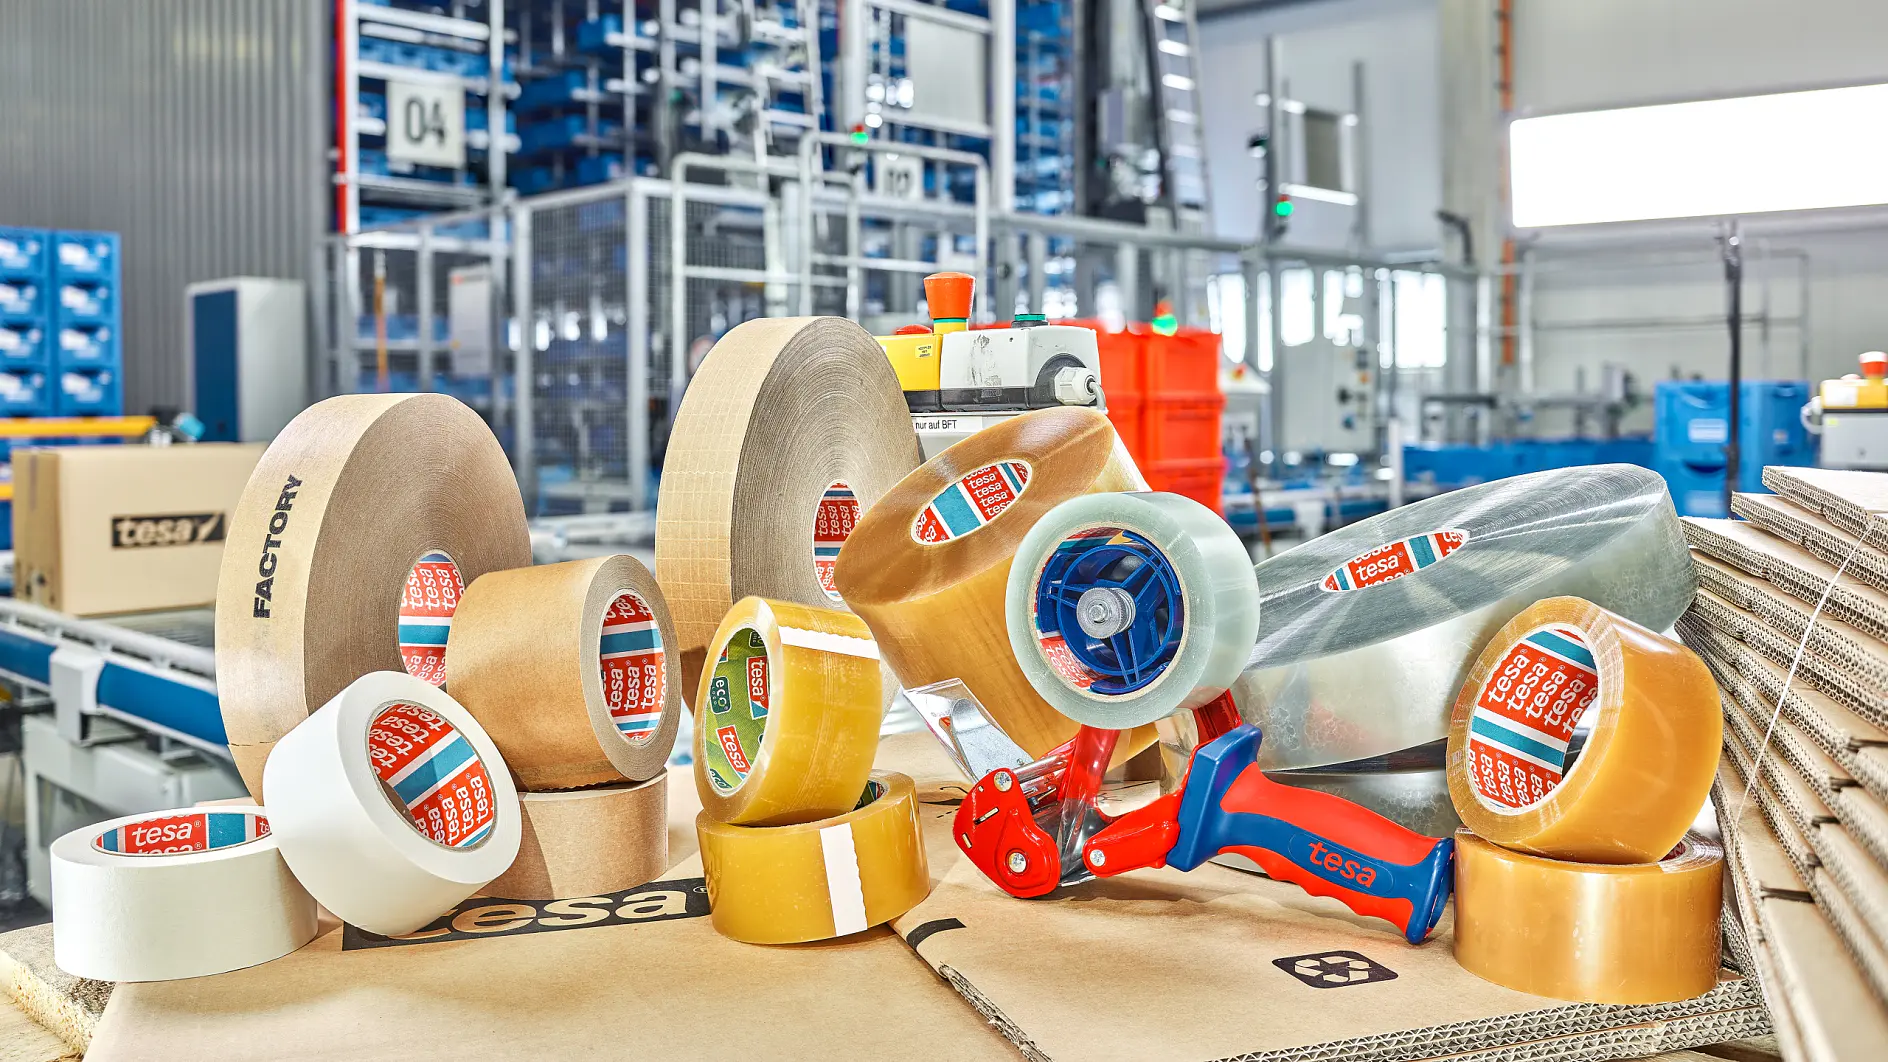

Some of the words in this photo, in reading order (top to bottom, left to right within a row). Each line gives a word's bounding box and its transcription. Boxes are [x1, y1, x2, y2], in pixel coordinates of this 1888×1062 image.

[404, 97, 446, 146] 04
[915, 422, 926, 430] nur
[929, 420, 940, 429] auf
[942, 419, 958, 429] BFT
[115, 517, 194, 545] tesa
[253, 474, 302, 618] FACTORY
[1308, 841, 1377, 888] tesa
